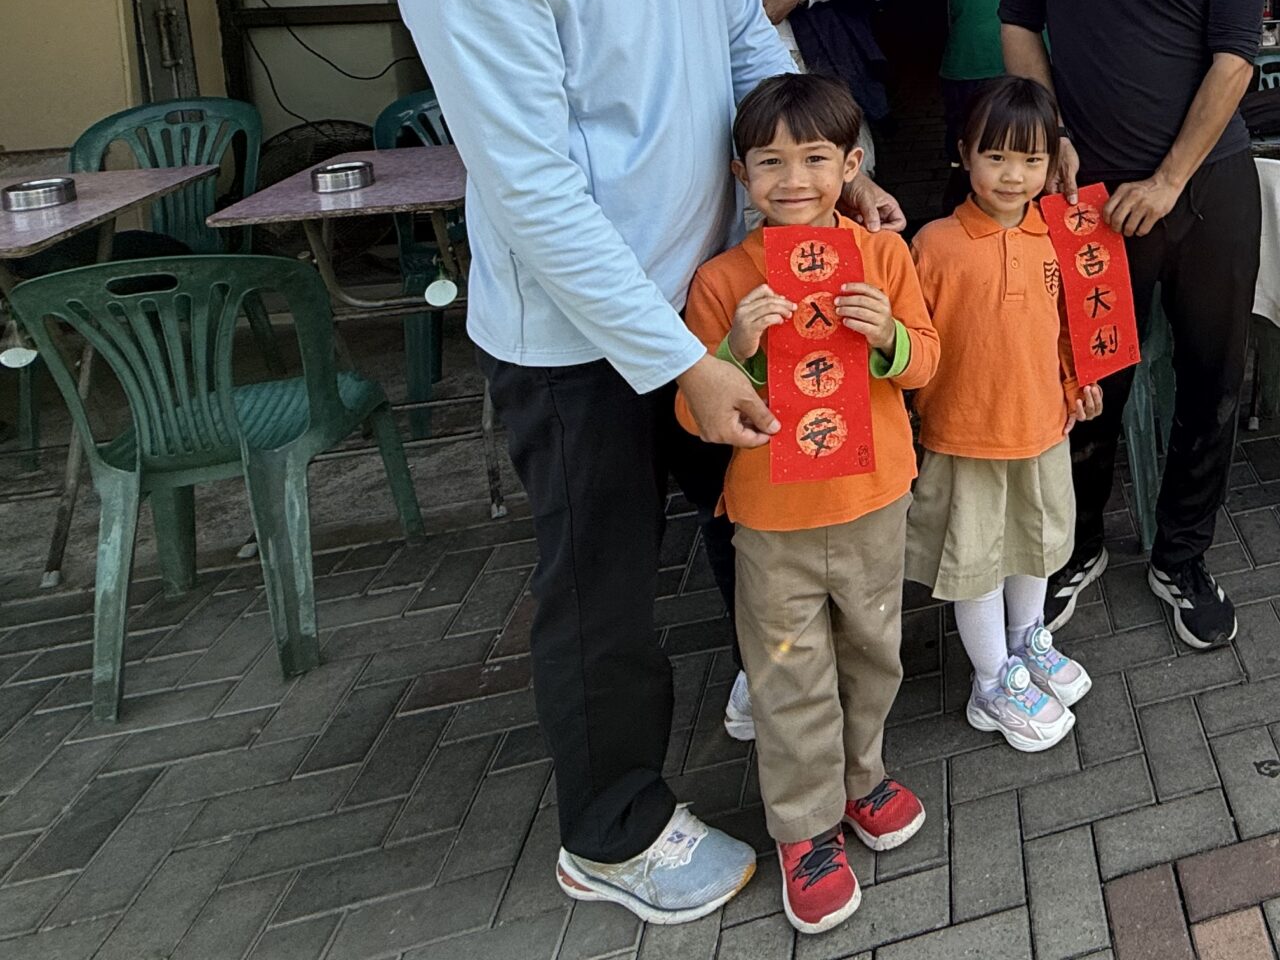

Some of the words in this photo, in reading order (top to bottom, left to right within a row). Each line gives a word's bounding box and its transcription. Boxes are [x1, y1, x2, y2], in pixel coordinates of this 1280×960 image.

[797, 242, 838, 460] 出入平安
[1069, 206, 1119, 356] 大吉大利
